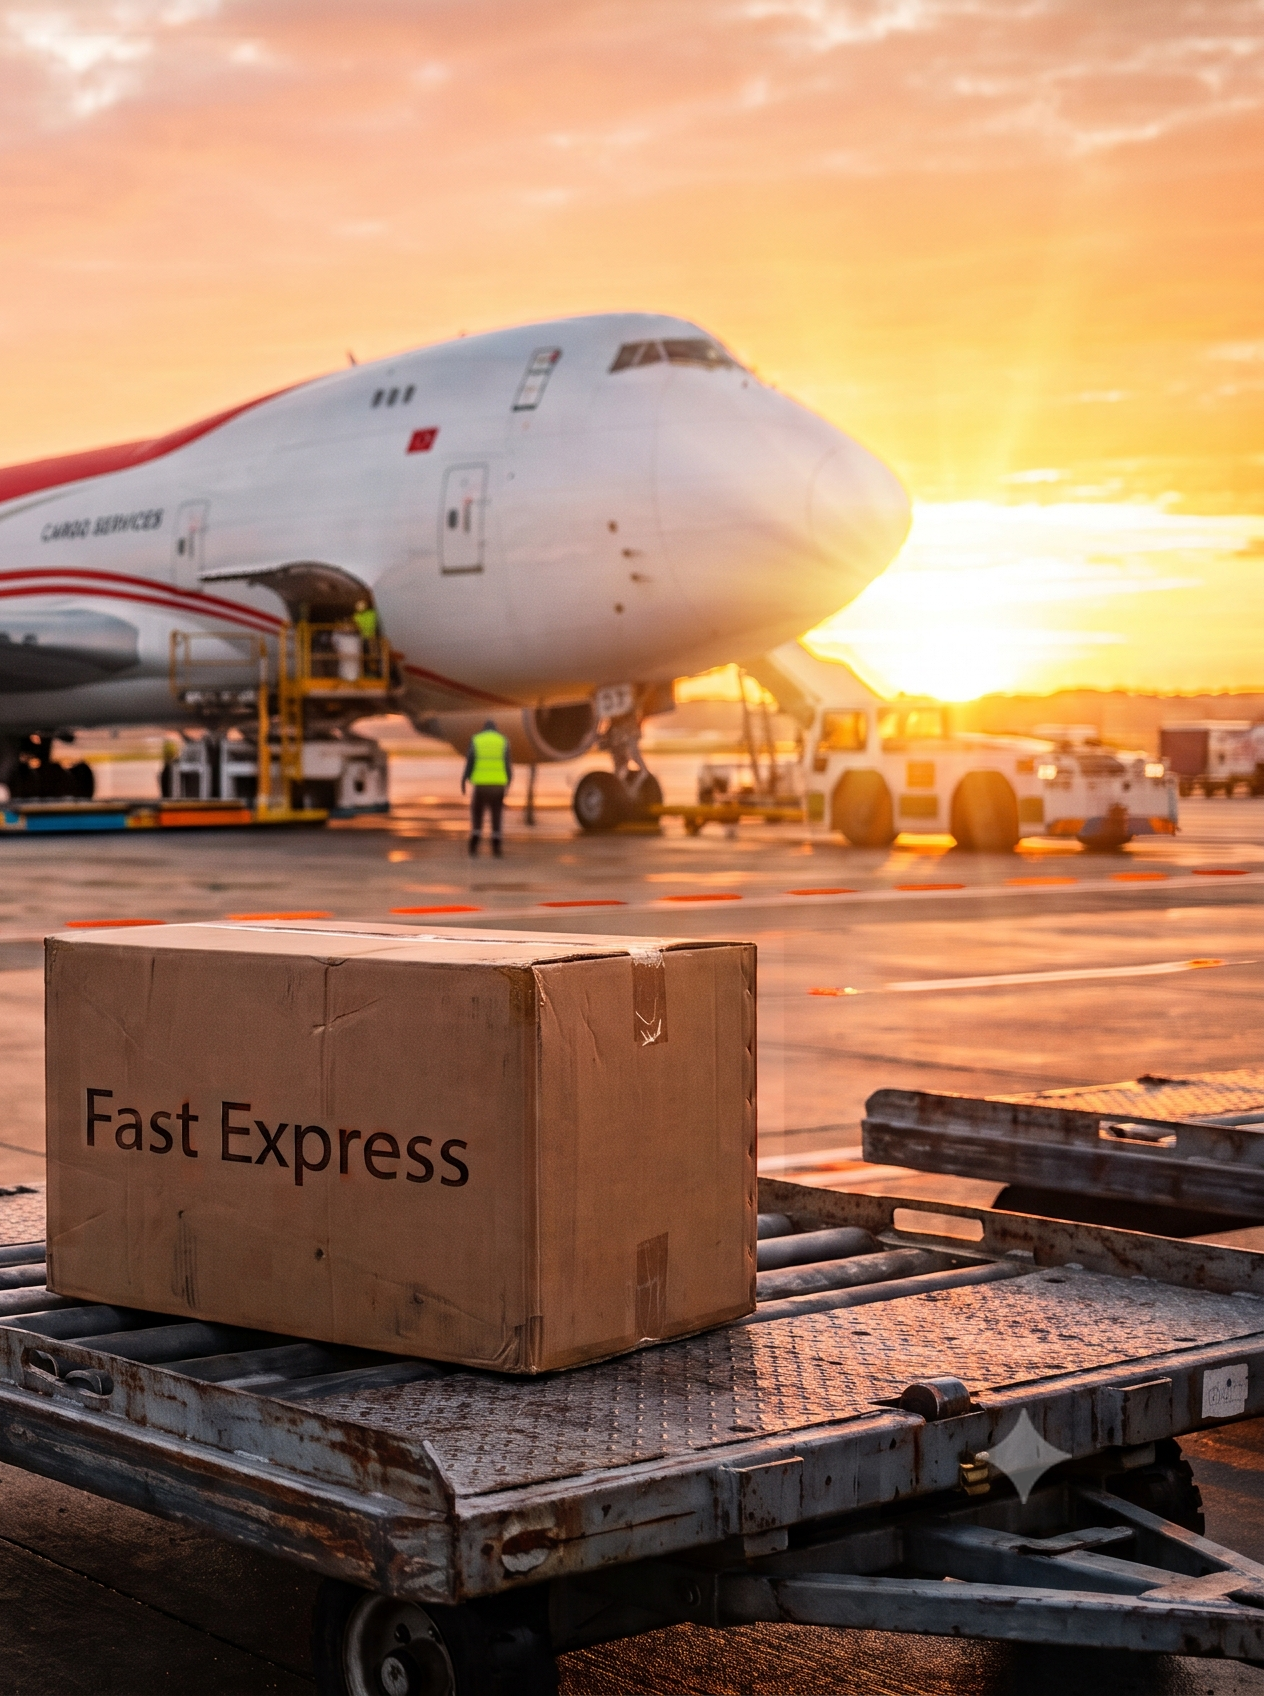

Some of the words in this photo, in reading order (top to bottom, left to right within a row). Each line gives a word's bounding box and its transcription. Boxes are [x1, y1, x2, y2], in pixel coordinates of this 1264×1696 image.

[93, 508, 164, 536] SERVICES
[86, 1087, 199, 1158] Fast
[221, 1101, 470, 1188] Express
